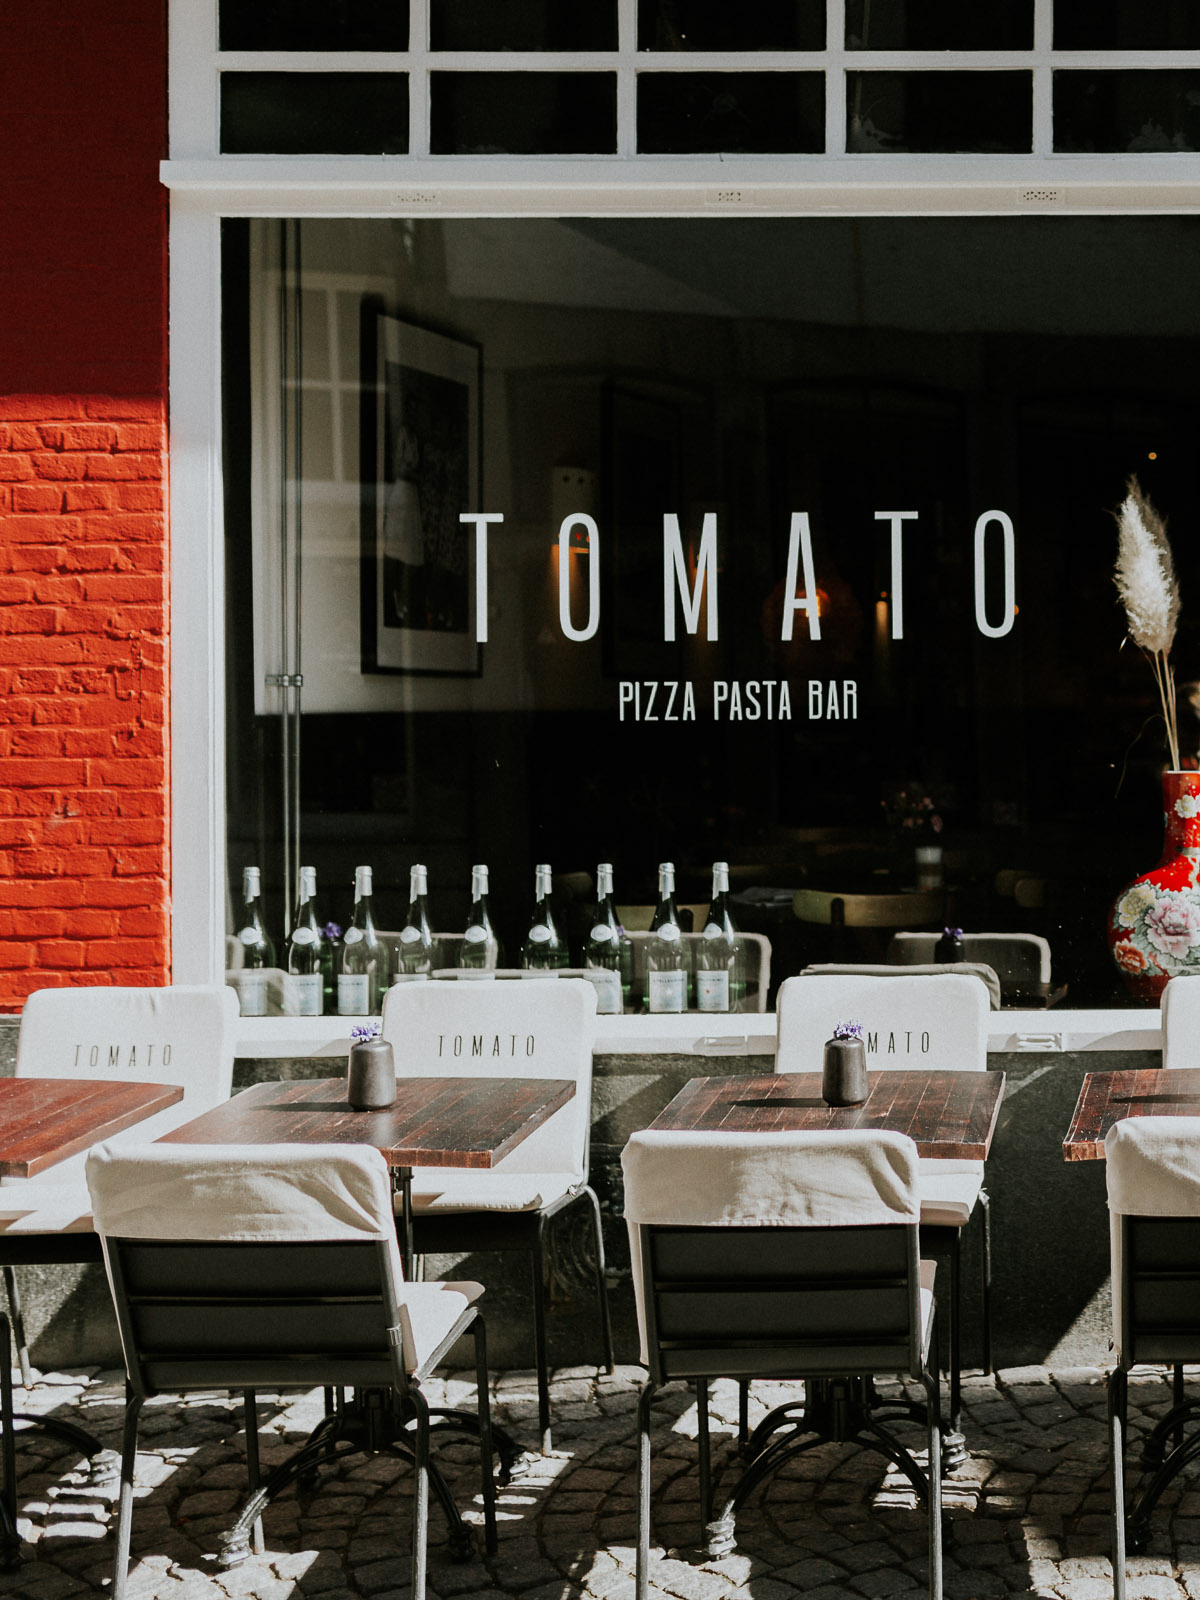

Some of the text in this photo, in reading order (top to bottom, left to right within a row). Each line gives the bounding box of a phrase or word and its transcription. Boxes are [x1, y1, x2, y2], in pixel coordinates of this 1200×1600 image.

[459, 510, 1016, 643] TOMATO
[619, 680, 858, 721] PIZZA PASTA BAR
[438, 1034, 535, 1057] TOMATO
[867, 1031, 930, 1054] MATO
[74, 1044, 172, 1067] TOMATO
